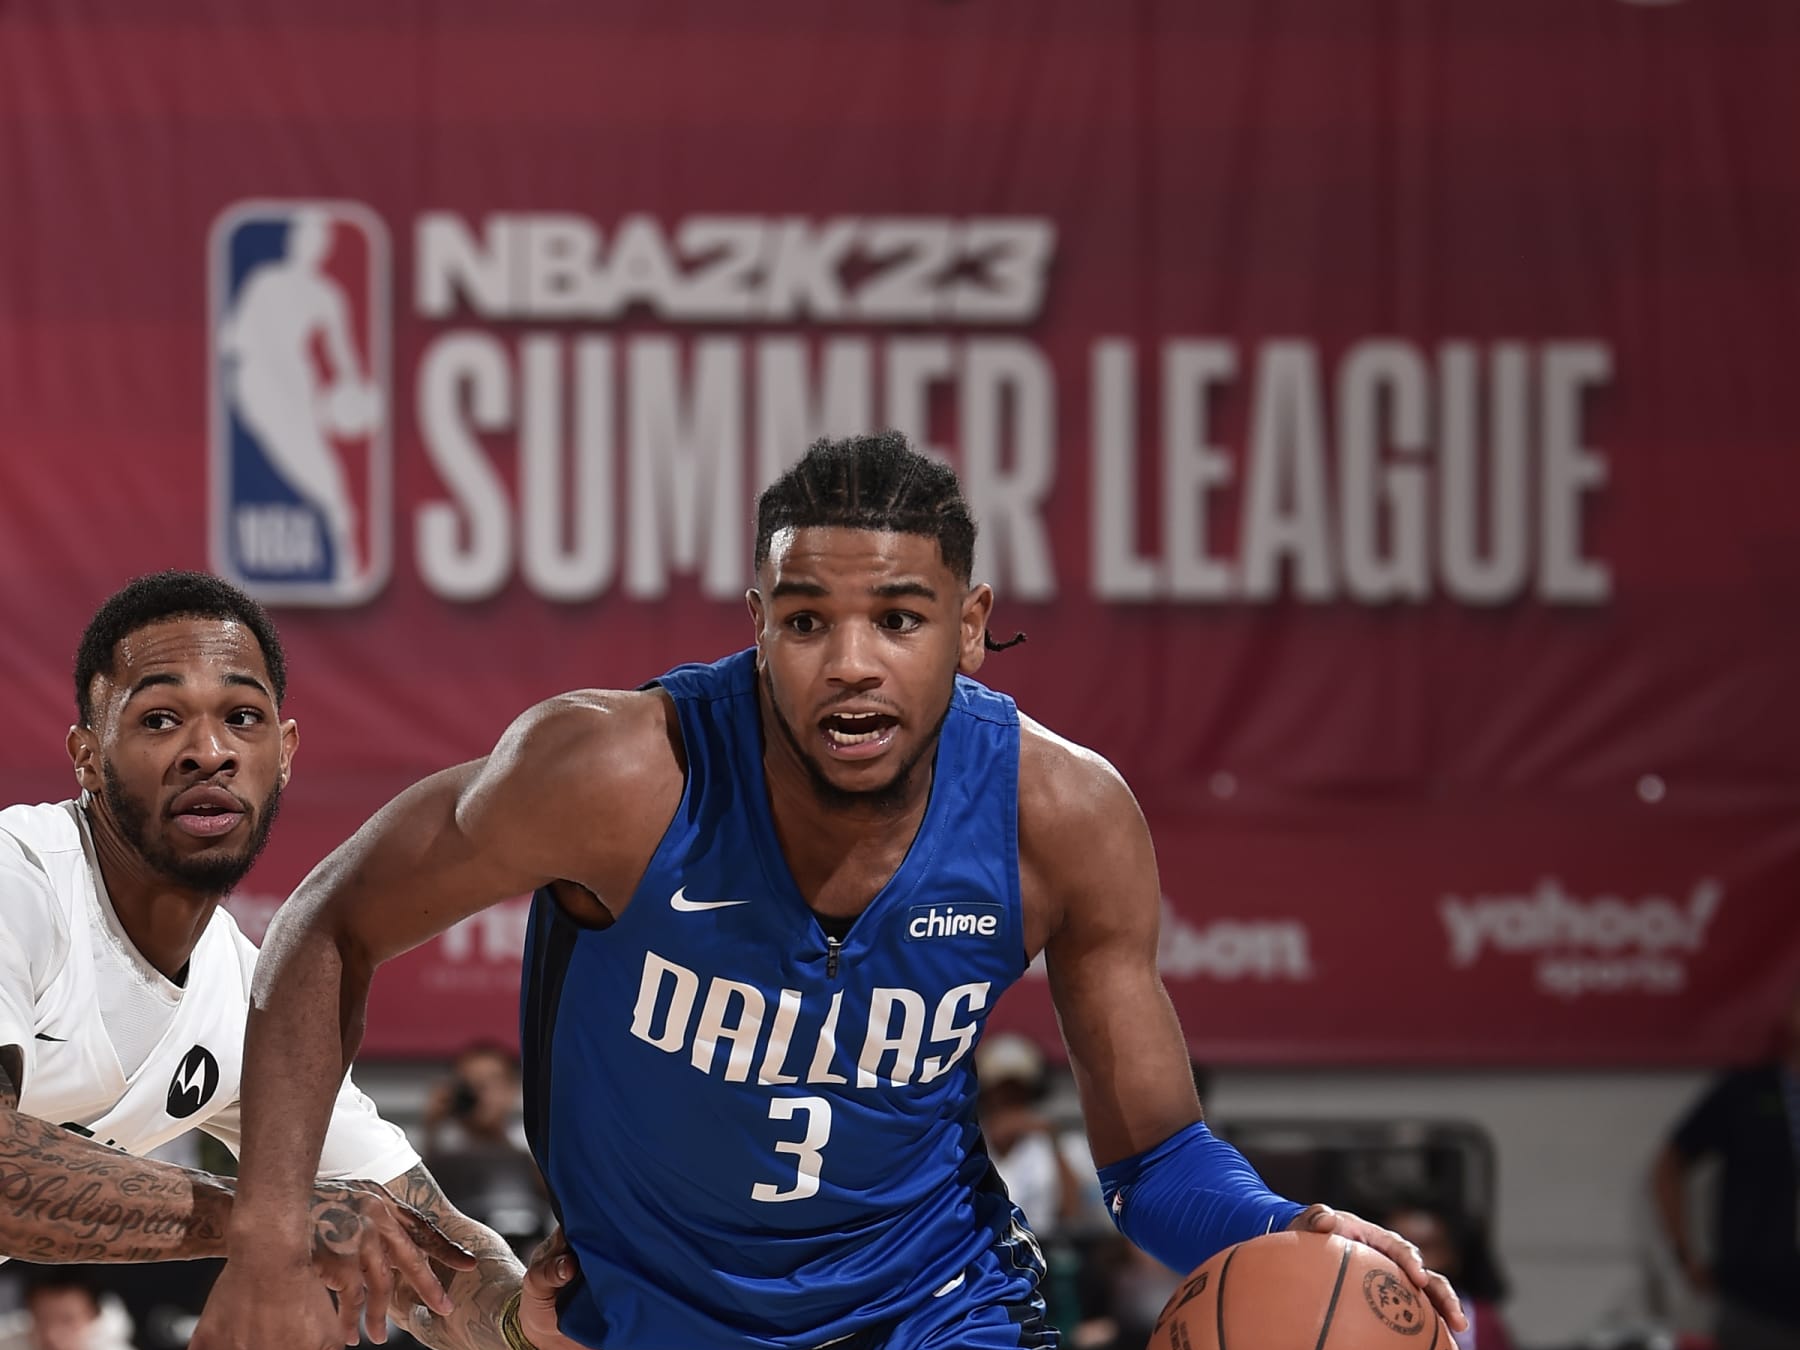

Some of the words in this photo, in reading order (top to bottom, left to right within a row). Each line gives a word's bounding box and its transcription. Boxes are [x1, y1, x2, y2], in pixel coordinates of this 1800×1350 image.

[414, 213, 1053, 323] NBA2K23
[1091, 338, 1614, 604] LEAGUE
[909, 907, 997, 938] chime
[1438, 878, 1722, 967] yahoo!
[630, 950, 992, 1089] DALLAS
[751, 1096, 832, 1202] 3
